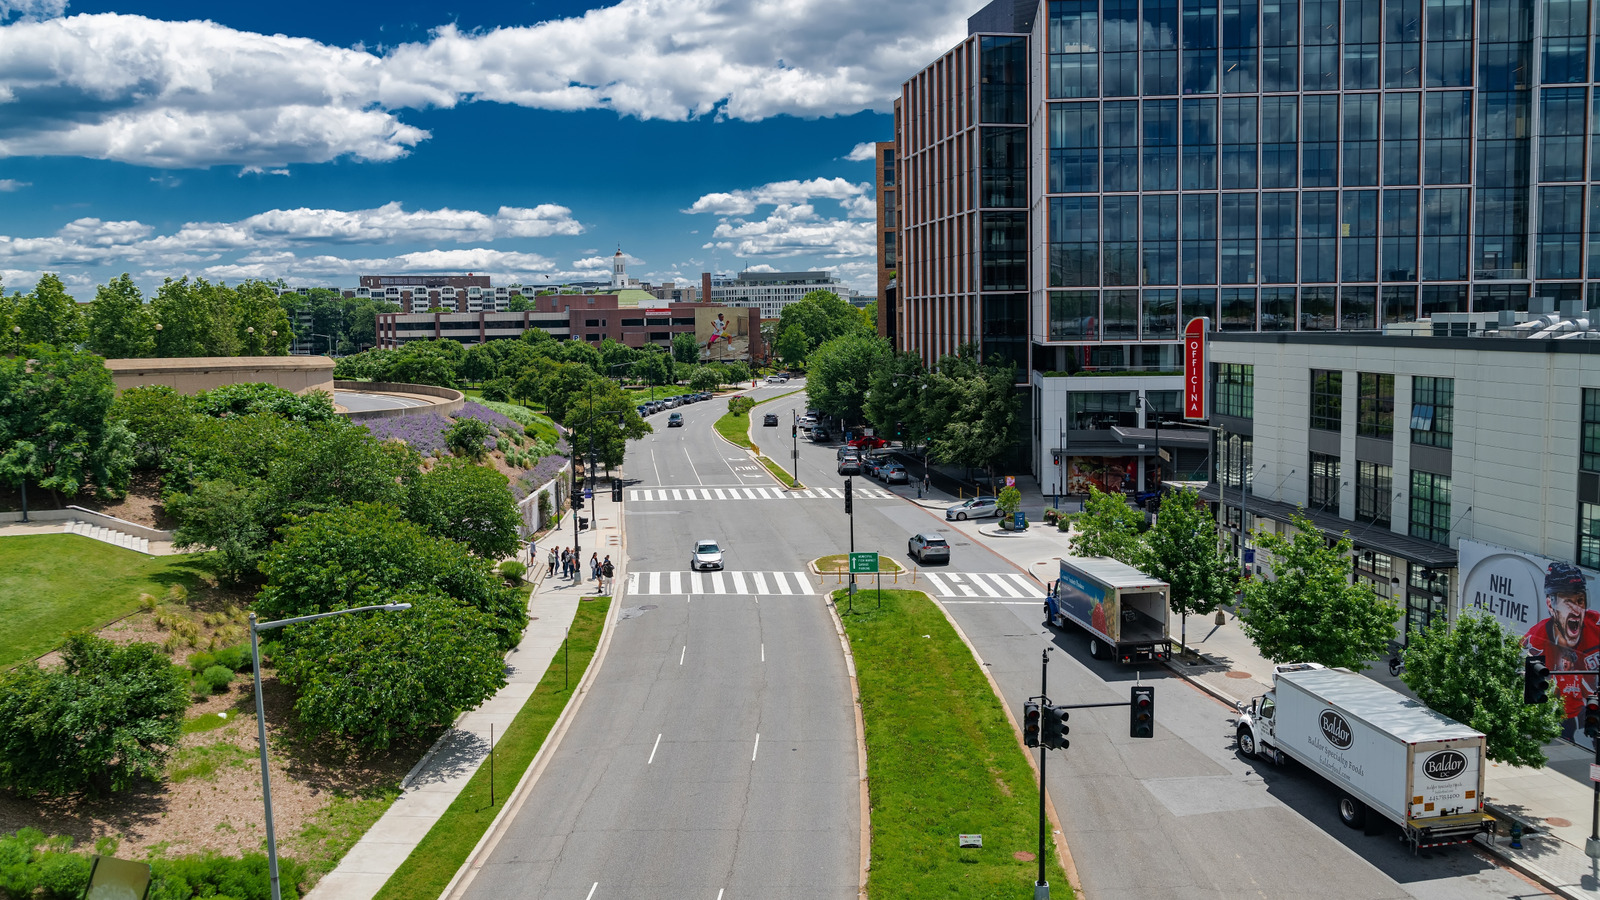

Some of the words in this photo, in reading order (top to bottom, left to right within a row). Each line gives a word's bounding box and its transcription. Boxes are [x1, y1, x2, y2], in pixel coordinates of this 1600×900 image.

[1190, 341, 1198, 411] OFFICINA
[1490, 573, 1514, 597] NHL
[1474, 591, 1529, 623] ALL-TIME
[1322, 716, 1350, 742] Baldor
[1331, 735, 1340, 745] DC
[1307, 735, 1324, 751] Baldor
[1324, 746, 1348, 769] Specialty
[1348, 761, 1364, 777] Foods
[1428, 754, 1463, 773] Baldor
